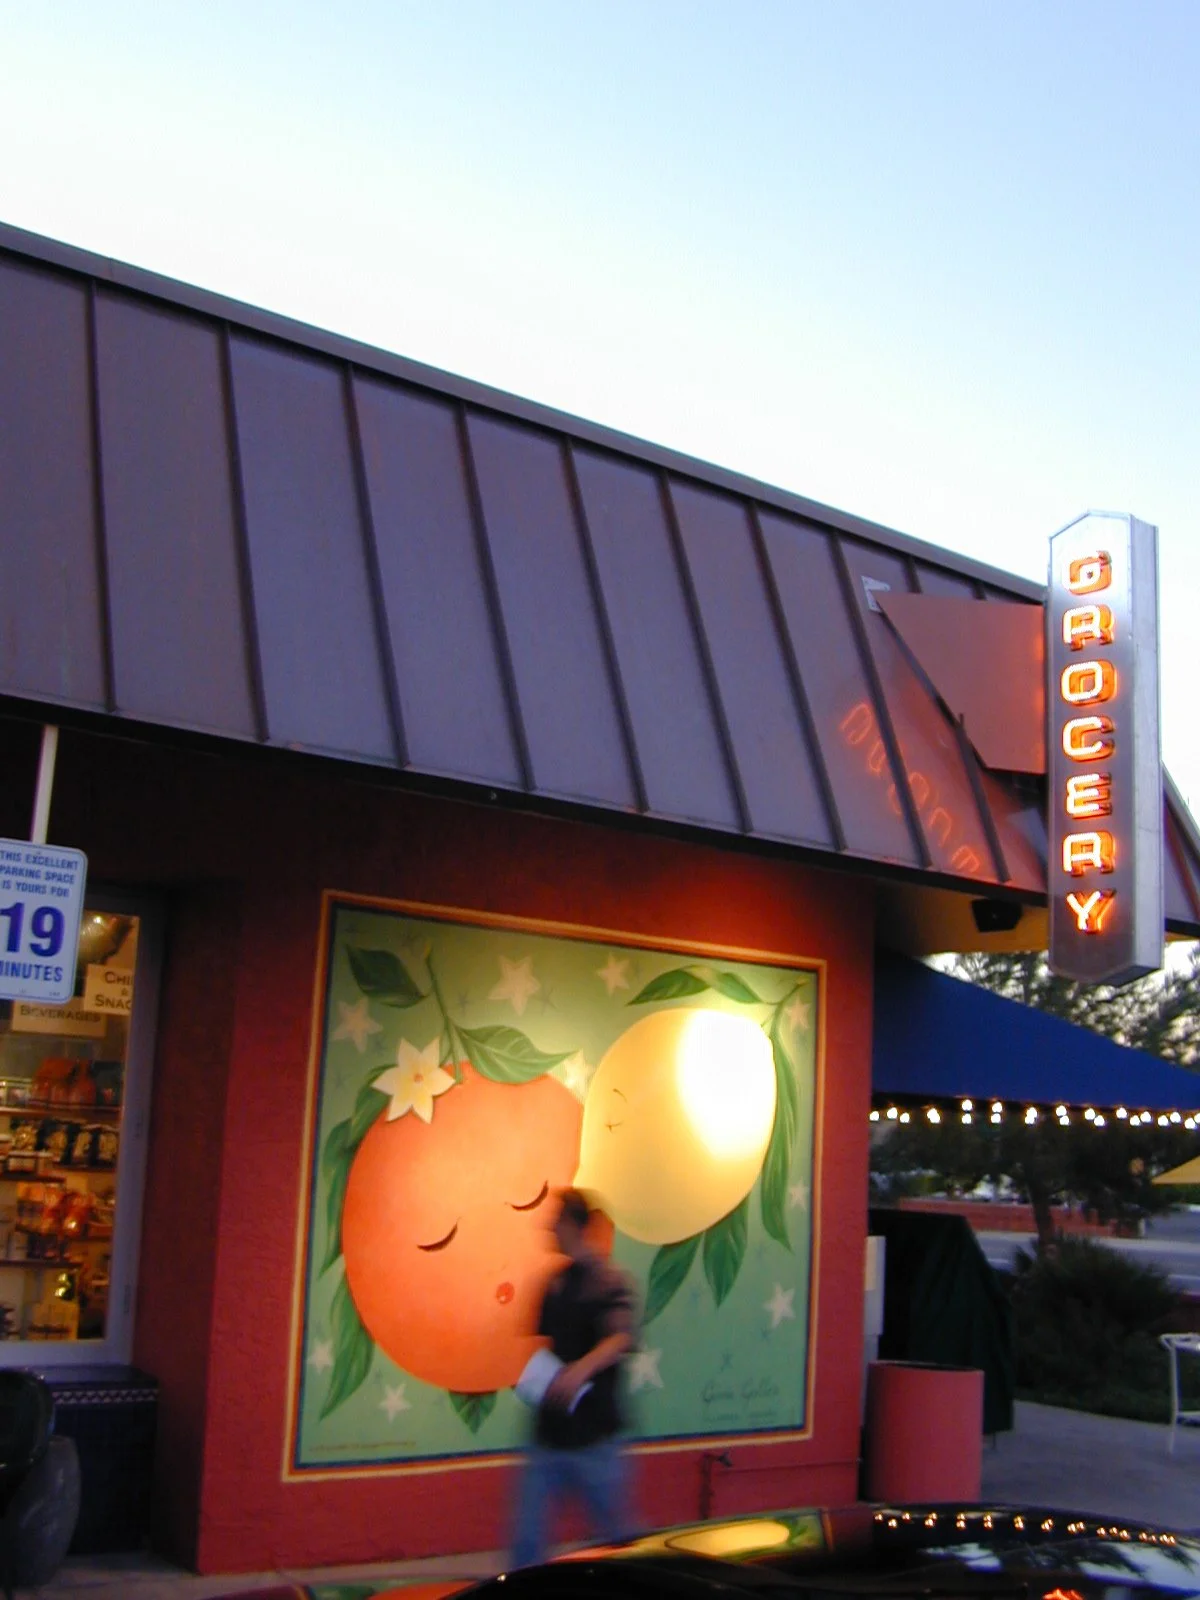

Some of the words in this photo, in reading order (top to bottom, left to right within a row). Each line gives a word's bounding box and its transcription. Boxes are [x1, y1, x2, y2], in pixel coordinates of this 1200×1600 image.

[1061, 550, 1117, 932] GROCERY
[0, 850, 22, 862] THIS
[25, 854, 78, 870] EXCELLENT
[0, 864, 41, 879] PARKING
[45, 871, 75, 884] SPACE
[2, 879, 12, 890] IS
[16, 881, 47, 895] YOURS
[50, 886, 70, 898] FOR
[0, 902, 65, 958] 19
